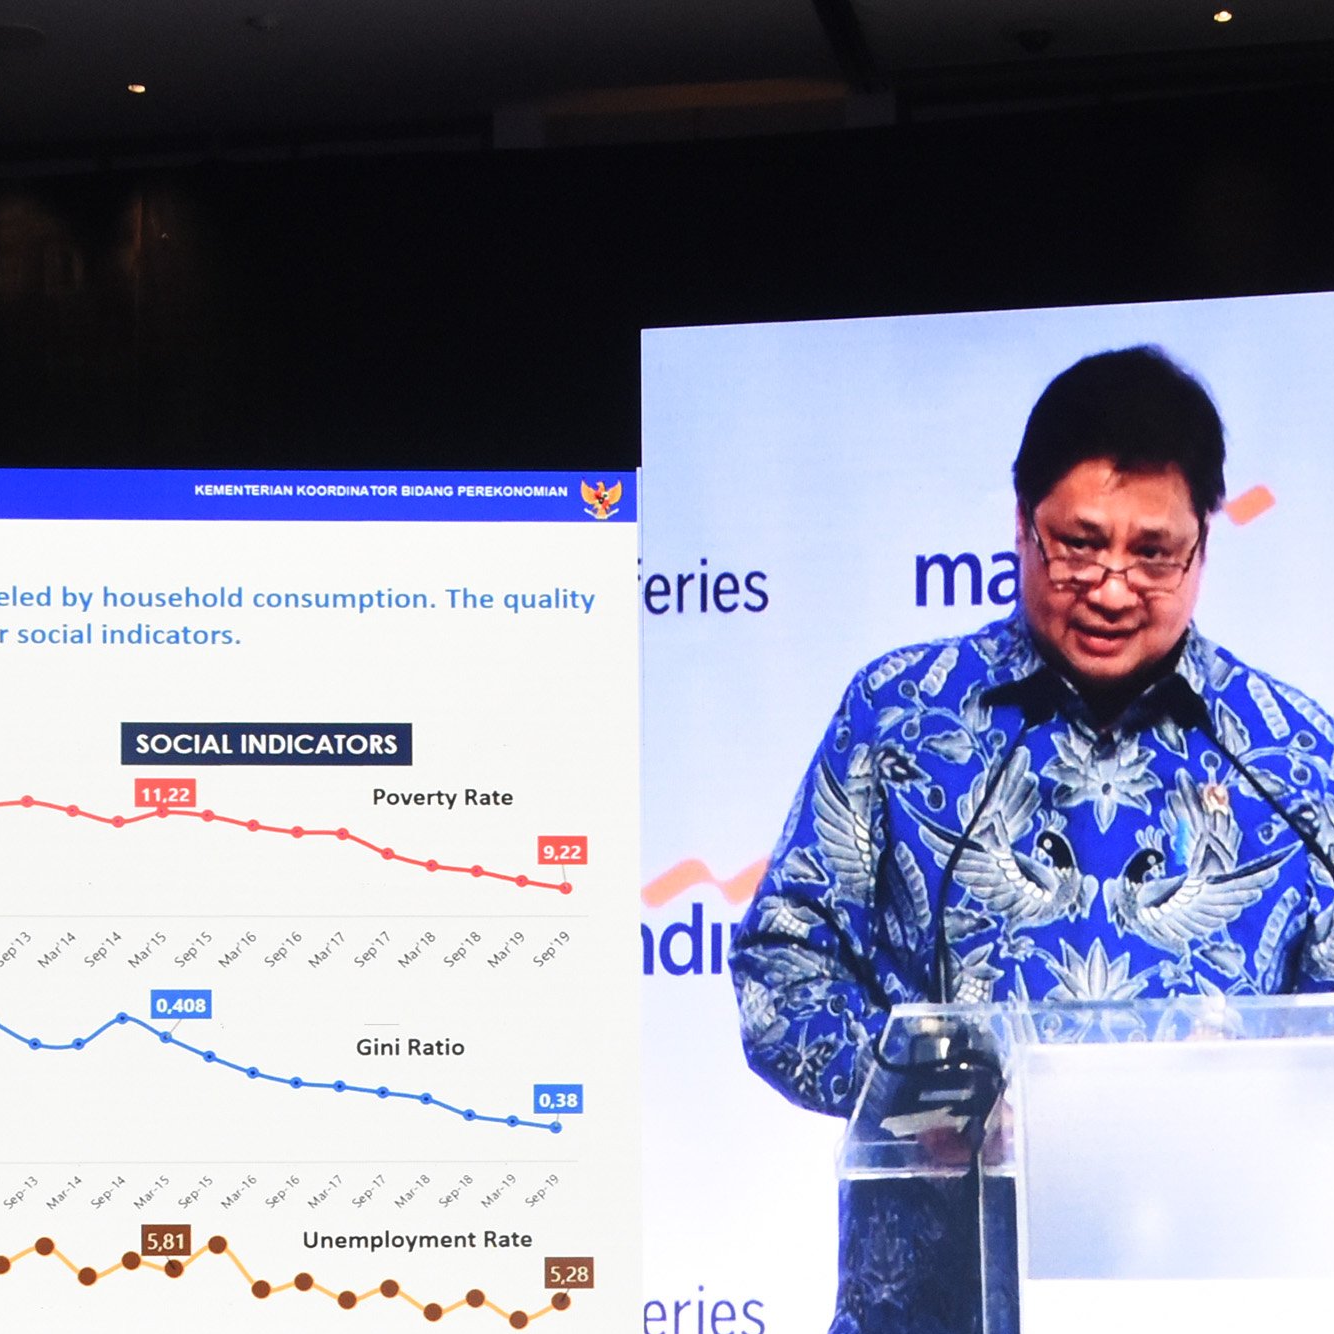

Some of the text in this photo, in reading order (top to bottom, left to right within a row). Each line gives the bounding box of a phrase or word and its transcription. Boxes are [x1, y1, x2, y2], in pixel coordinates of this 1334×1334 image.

[194, 484, 568, 498] KEMENTERIAN KOORDINATOR BIDANG PEREKONOMIAN
[62, 585, 94, 613] by
[103, 585, 243, 608] household
[252, 587, 436, 614] consumption.
[444, 587, 494, 609] The
[503, 587, 596, 615] quality
[17, 622, 92, 645] social
[102, 622, 241, 645] indicators.
[135, 733, 398, 755] SOCIAL INDICATORS
[141, 787, 190, 804] 11,22
[373, 788, 514, 811] Poverty Rate
[543, 844, 582, 861] 9,22
[155, 998, 207, 1015] 0,408
[356, 1037, 465, 1056] Gini Ratio
[538, 1092, 579, 1110] 0,38
[146, 1231, 185, 1252] 5,81
[303, 1229, 533, 1253] Unemployment Rate
[549, 1264, 589, 1284] 5,28
